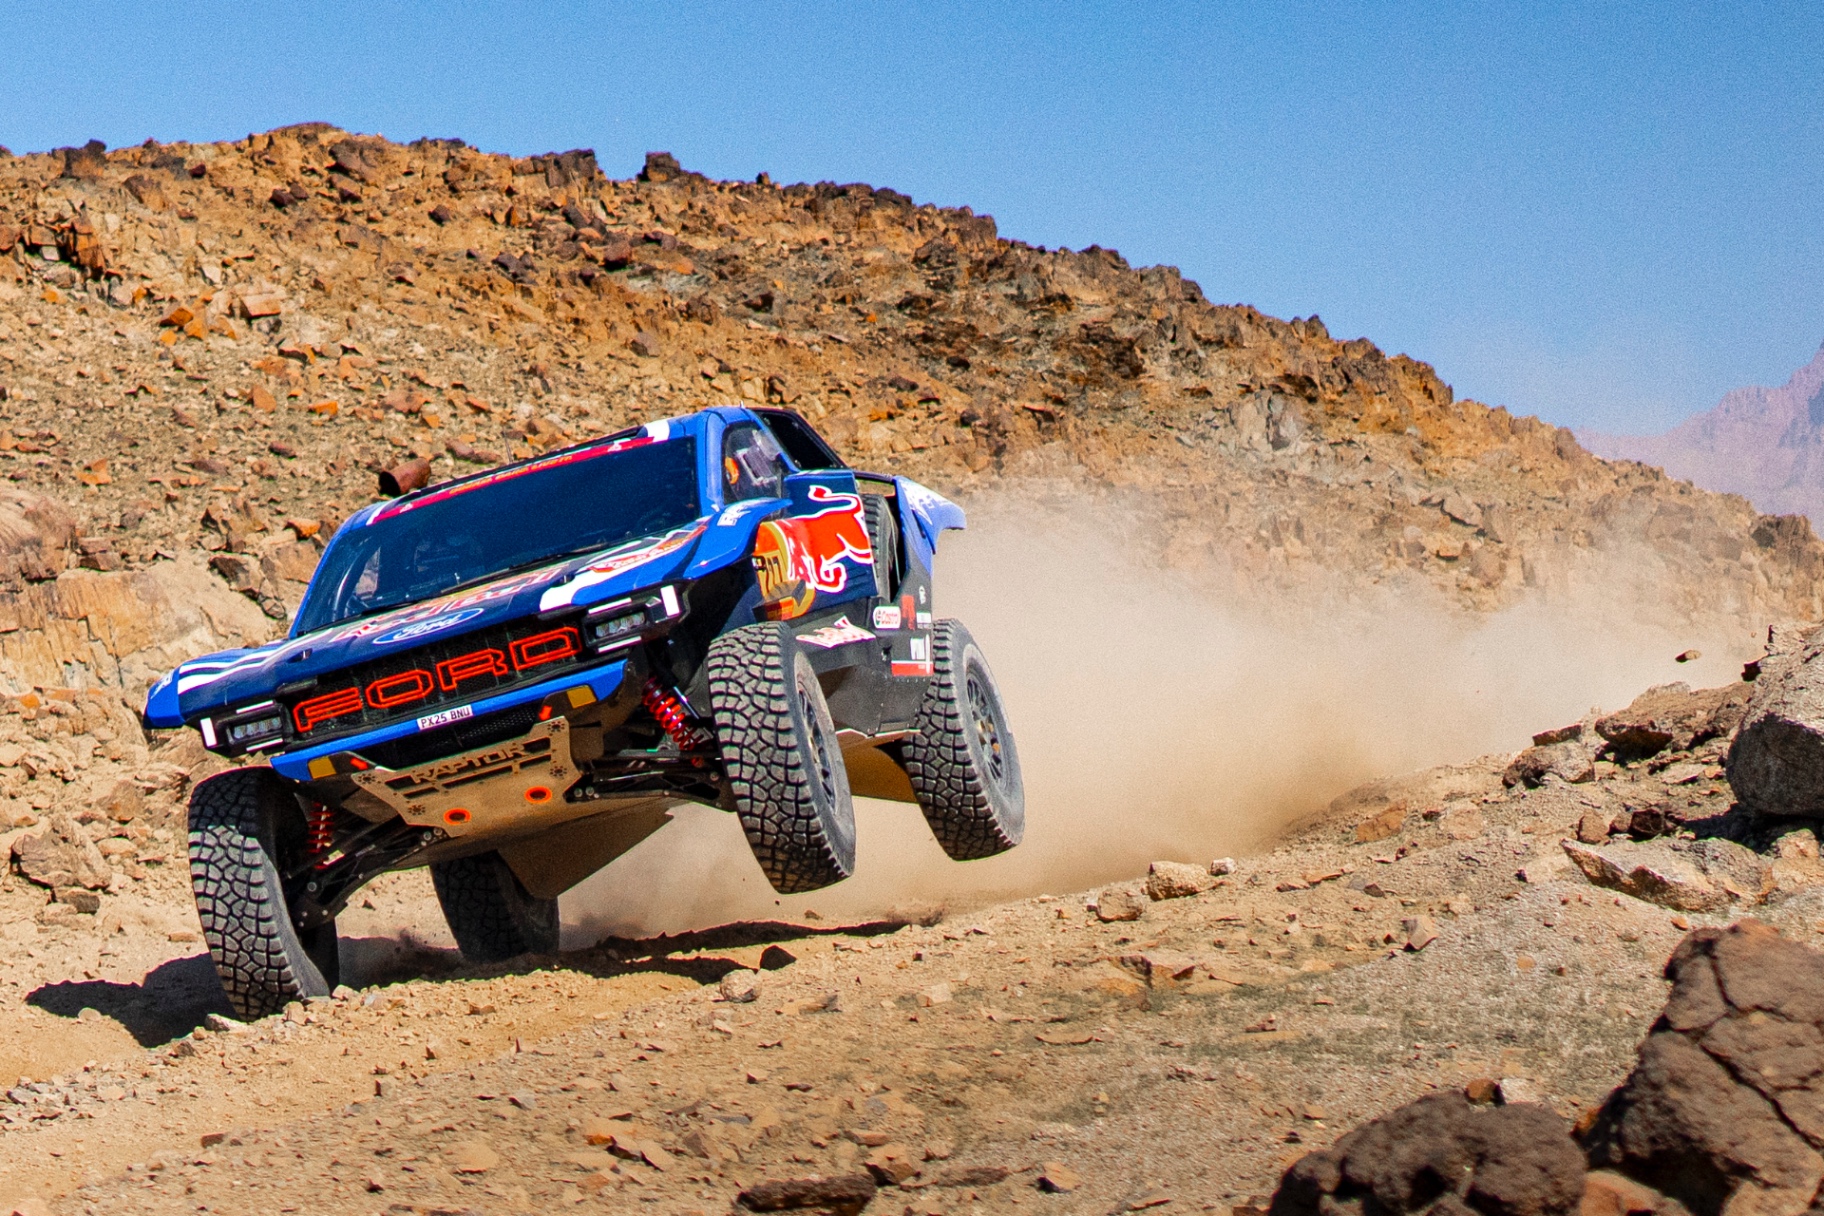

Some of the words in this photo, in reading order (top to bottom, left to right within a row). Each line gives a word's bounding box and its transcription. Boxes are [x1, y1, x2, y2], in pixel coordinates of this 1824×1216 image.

[393, 613, 463, 640] Ford
[293, 627, 582, 732] FORD
[420, 712, 448, 728] PX25
[450, 706, 471, 720] BNU
[410, 743, 528, 785] RAPTOR
